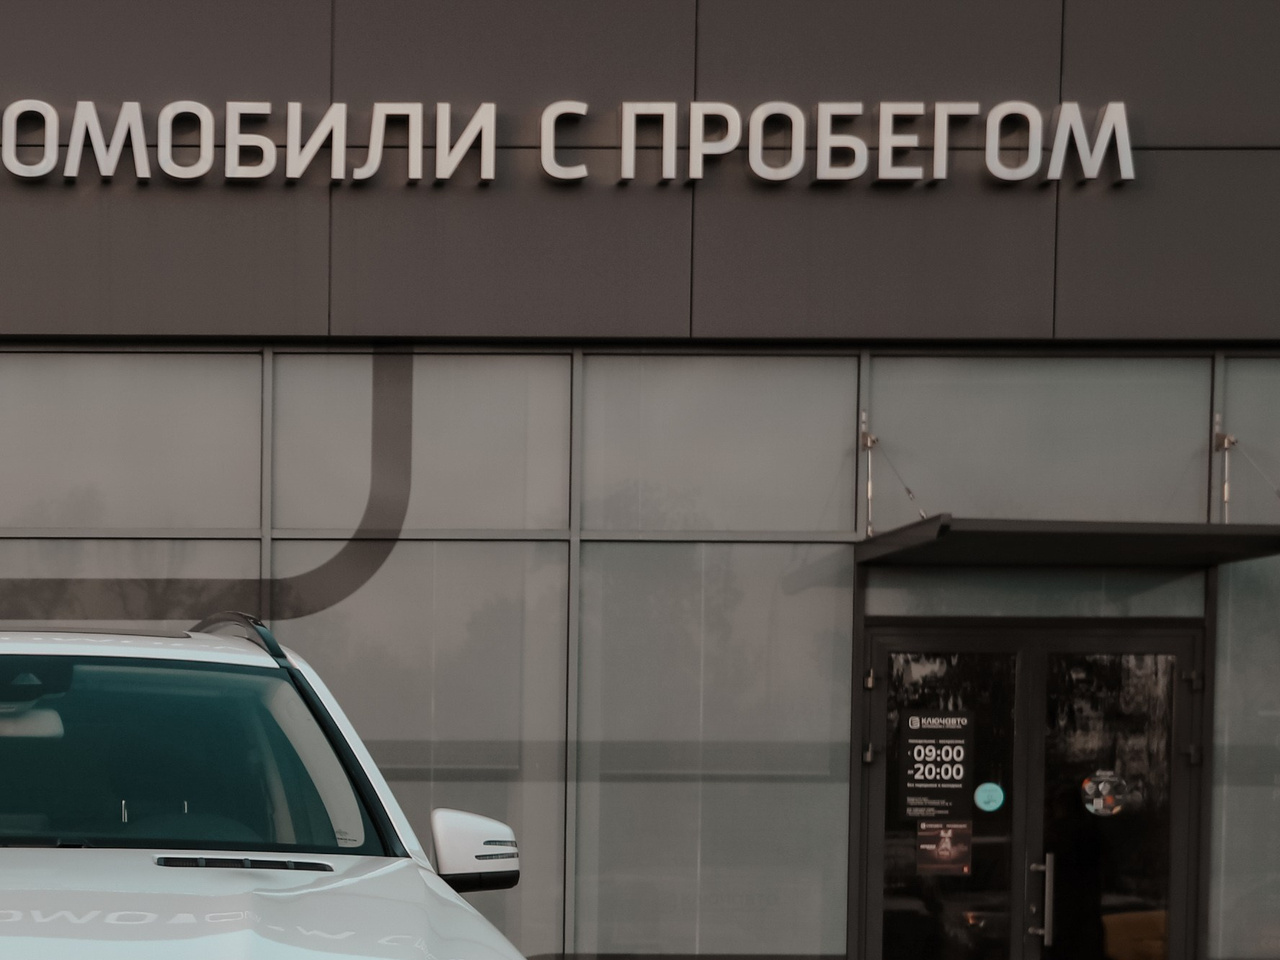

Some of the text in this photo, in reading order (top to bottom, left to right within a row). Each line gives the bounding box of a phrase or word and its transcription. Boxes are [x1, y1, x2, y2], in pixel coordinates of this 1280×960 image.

[539, 101, 589, 181] С
[621, 101, 1136, 181] ПРОБЕГОМ
[913, 745, 965, 762] 09:00
[913, 763, 964, 780] 20:00
